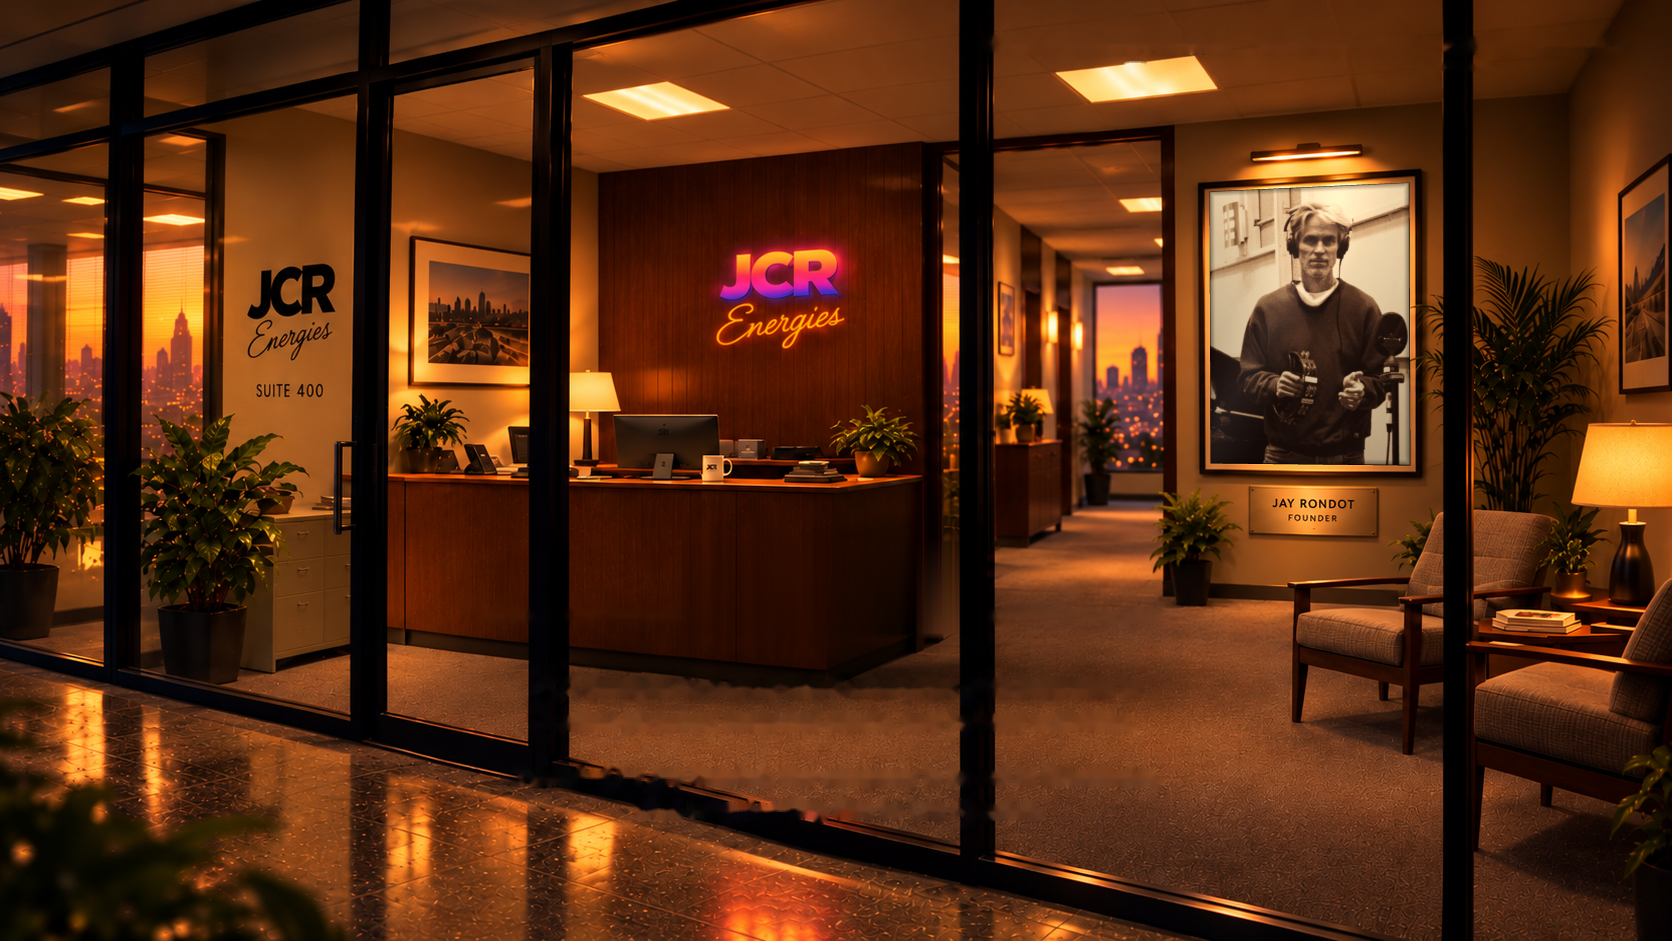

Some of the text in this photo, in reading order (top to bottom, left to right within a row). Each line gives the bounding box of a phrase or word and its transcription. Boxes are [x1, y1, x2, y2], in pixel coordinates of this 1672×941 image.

[247, 263, 336, 319] JCR
[718, 249, 840, 300] JCR
[247, 319, 333, 361] Energies
[716, 303, 845, 349] Energies
[256, 383, 324, 398] SUITE 400
[1272, 498, 1355, 509] JAY RONDOT
[1288, 514, 1338, 522] FOUNDER
